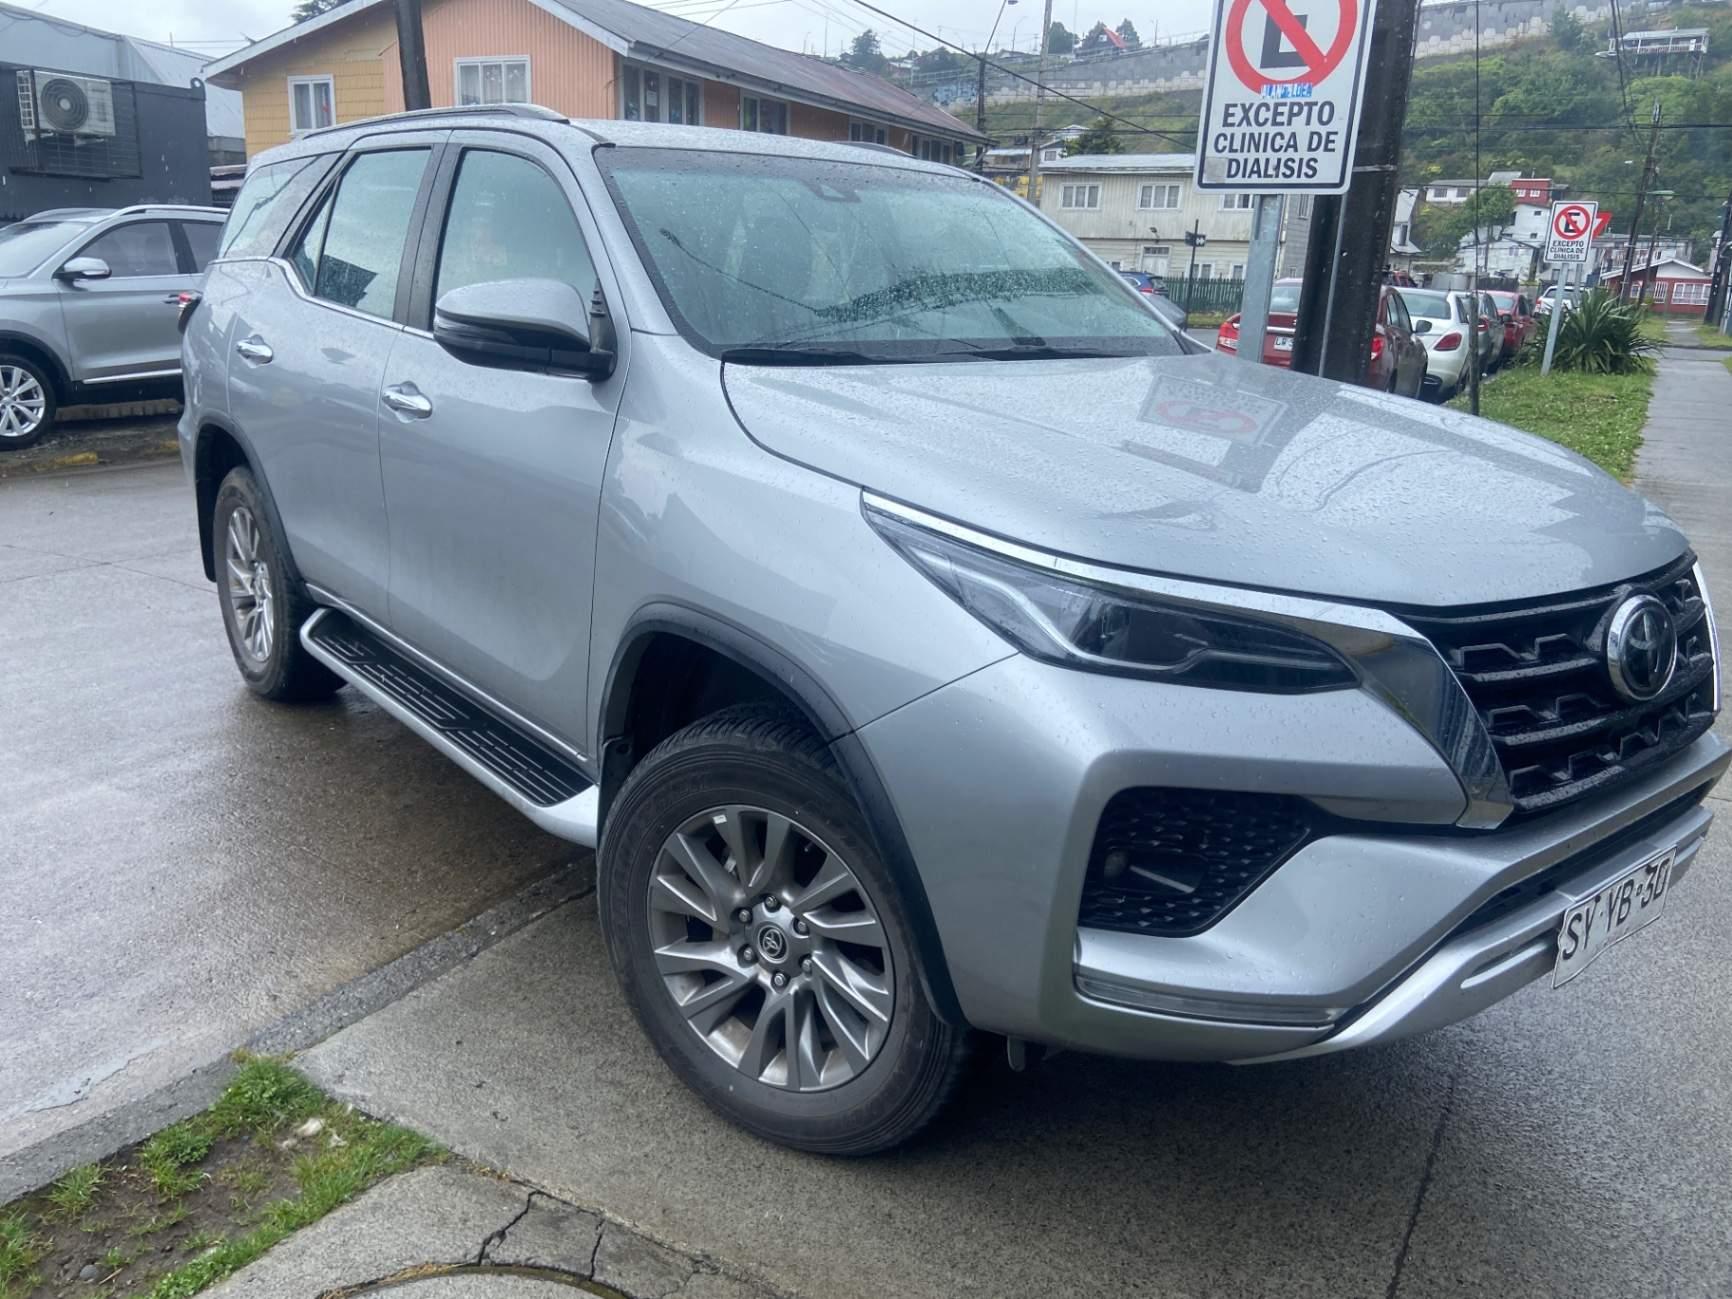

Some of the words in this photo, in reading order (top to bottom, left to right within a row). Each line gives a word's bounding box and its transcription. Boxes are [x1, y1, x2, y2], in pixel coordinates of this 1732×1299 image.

[1222, 101, 1335, 128] EXCEPTO
[1214, 132, 1298, 153] CLINICA
[1307, 131, 1338, 152] DE
[1226, 158, 1318, 178] DIALISIS
